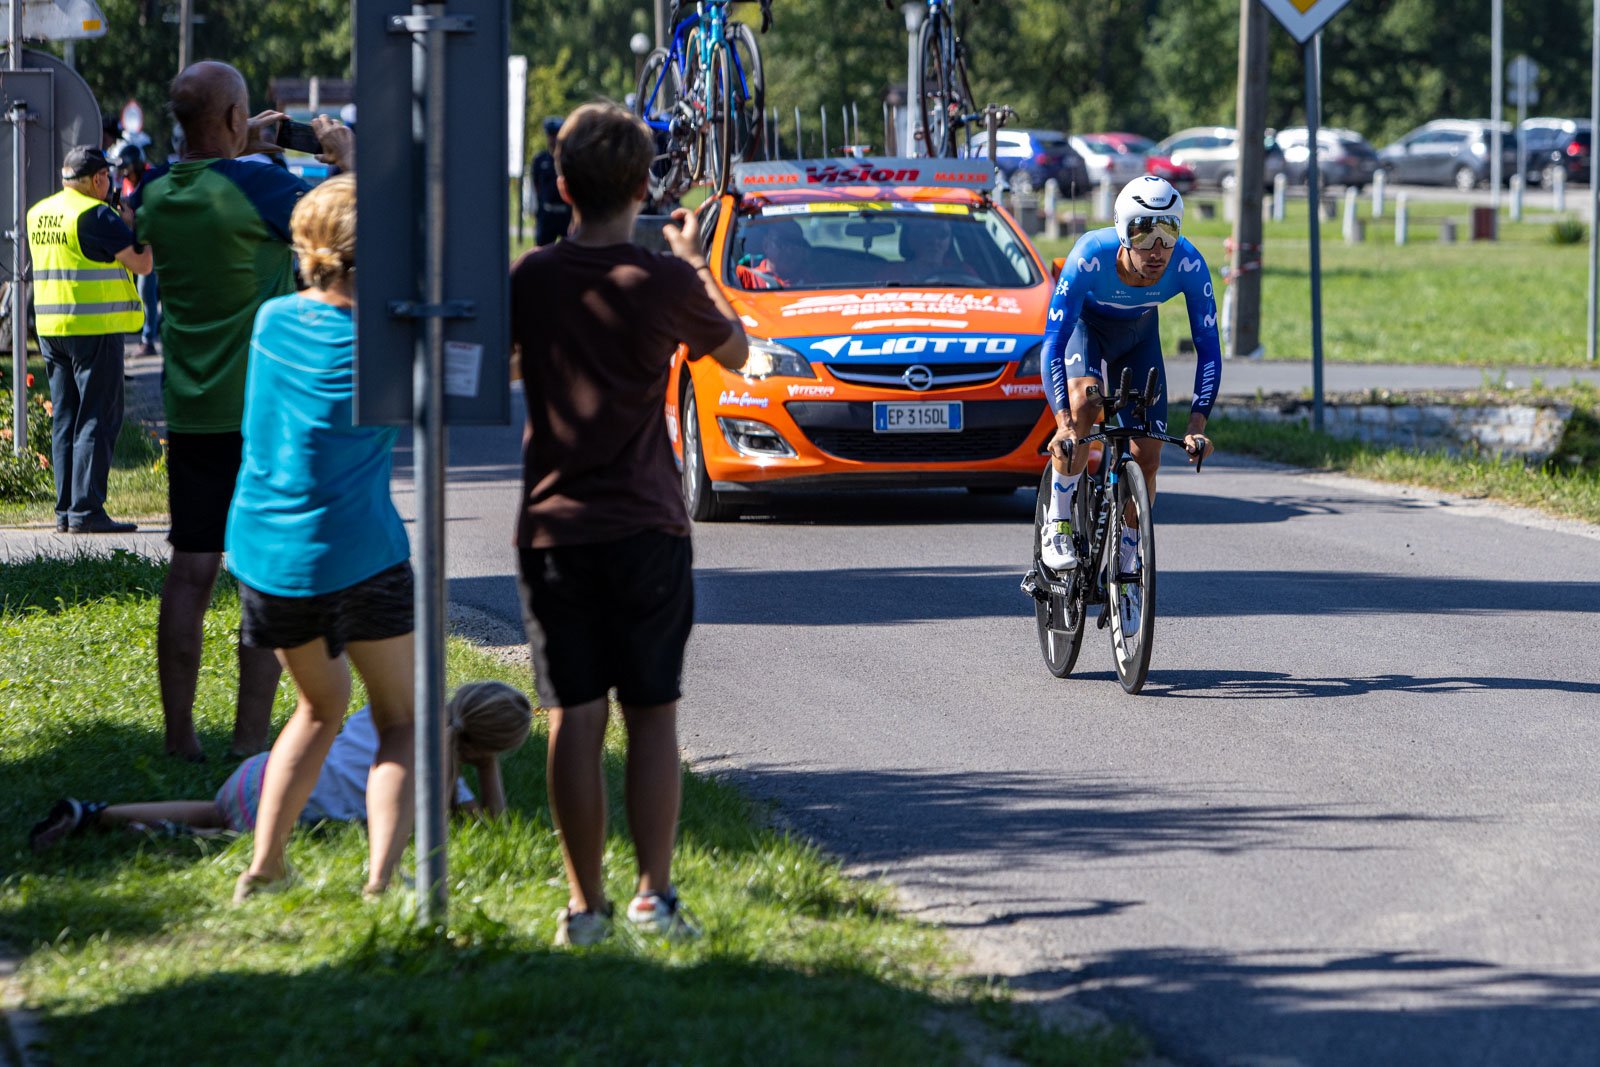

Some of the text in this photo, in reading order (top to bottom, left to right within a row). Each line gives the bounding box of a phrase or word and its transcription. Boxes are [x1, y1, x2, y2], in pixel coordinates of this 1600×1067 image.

[31, 230, 68, 246] POŻARNA
[848, 336, 1017, 357] LIOTTO
[1050, 357, 1066, 404] CANYON
[1198, 360, 1216, 407] CANYON
[888, 408, 904, 425] EP
